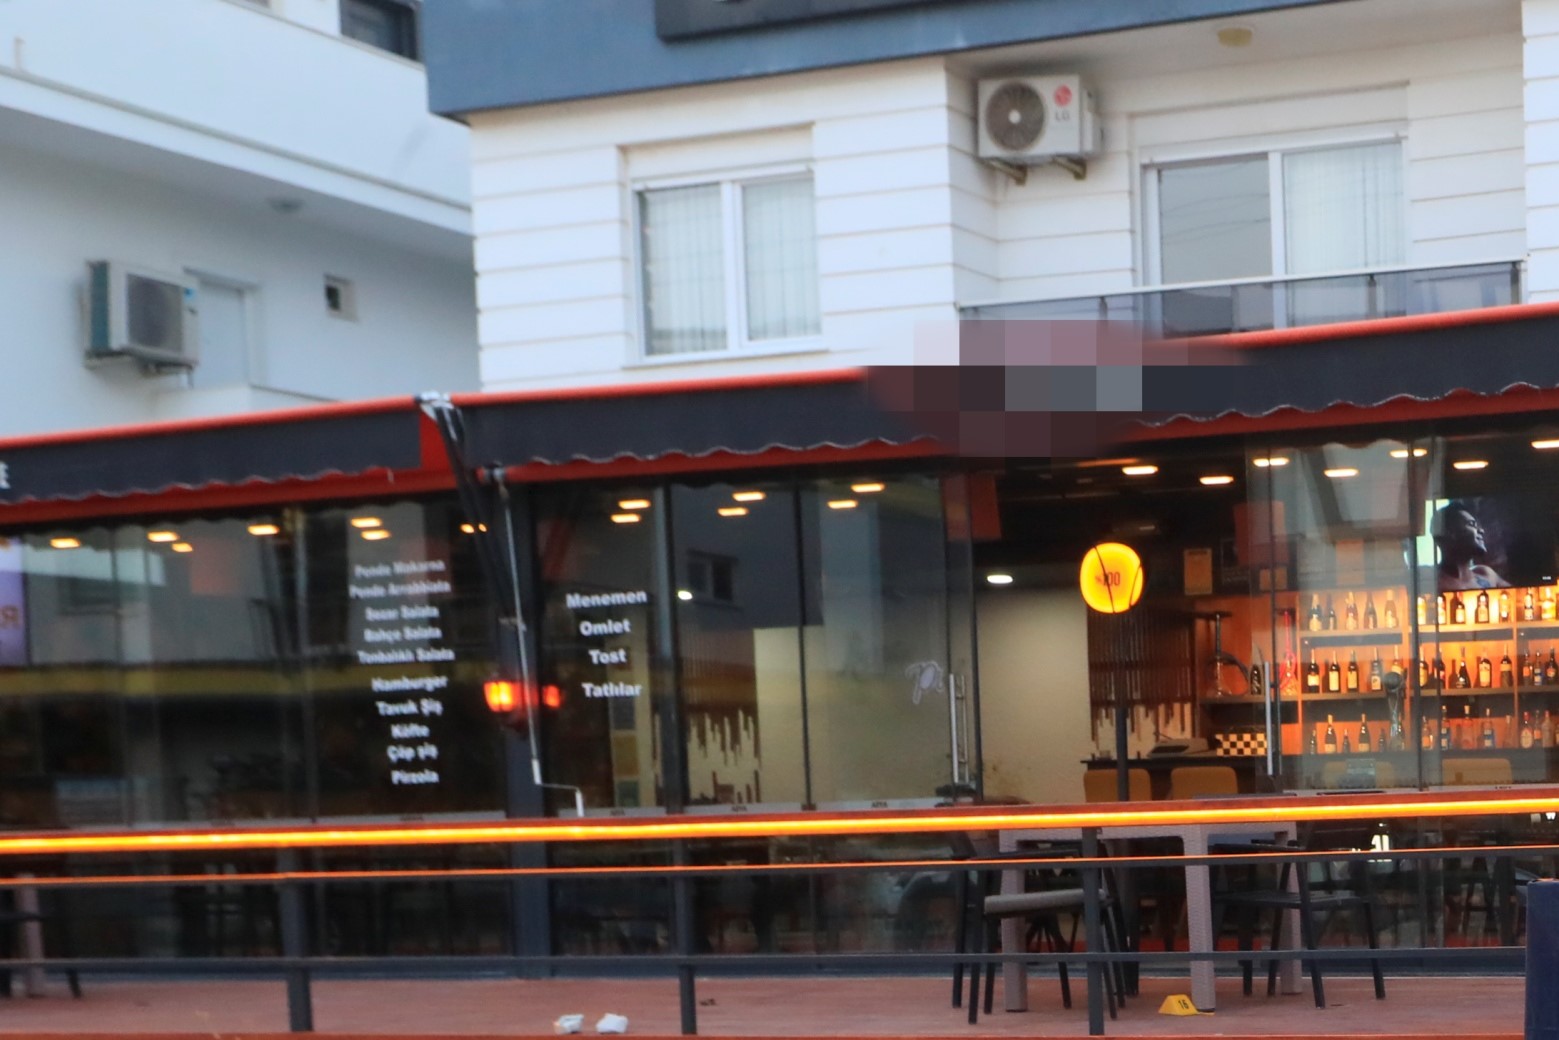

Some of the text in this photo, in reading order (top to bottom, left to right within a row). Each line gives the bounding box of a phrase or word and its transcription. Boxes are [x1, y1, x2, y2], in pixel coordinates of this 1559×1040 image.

[566, 591, 648, 609] Menemen
[401, 605, 439, 619] Salata
[404, 626, 442, 640] Salata
[580, 619, 632, 636] Omlet
[416, 648, 455, 661] Salata
[588, 649, 627, 664] Tost
[371, 676, 448, 692] Hamburger
[582, 682, 642, 697] Tatlılar
[391, 723, 430, 739] Köfte
[391, 769, 439, 784] Pirzola
